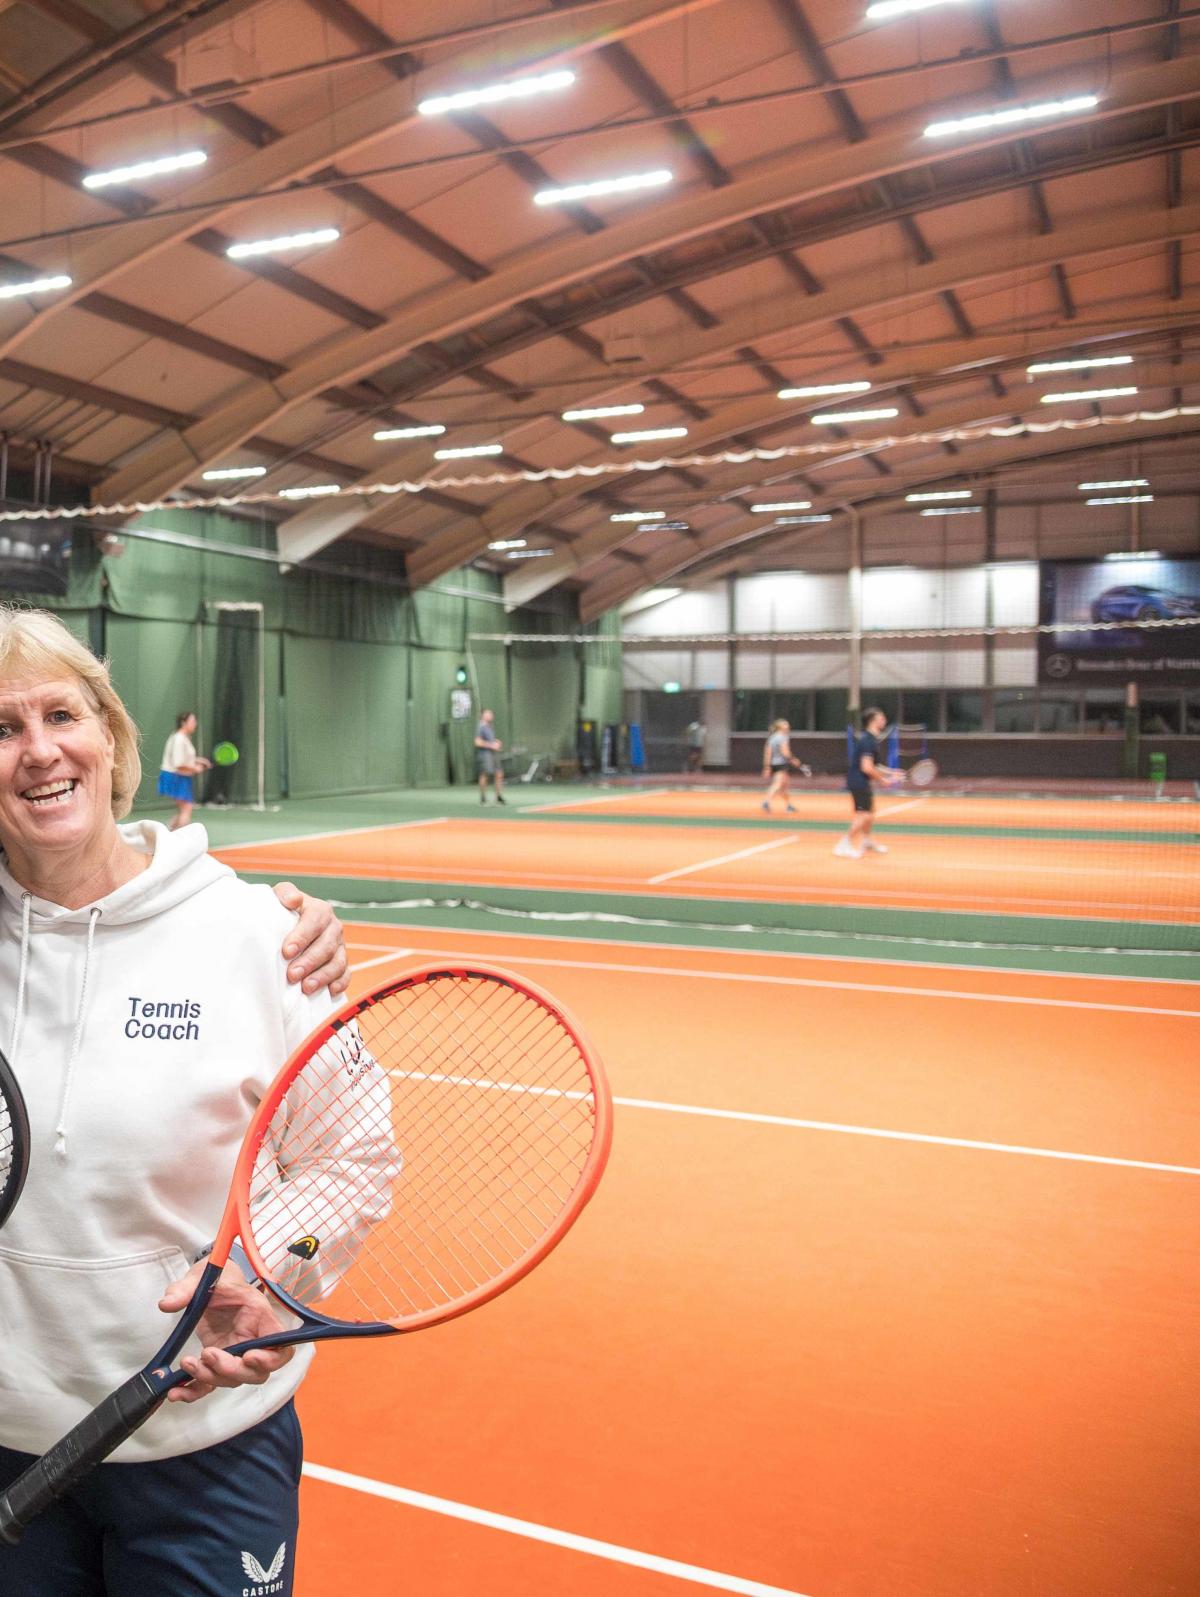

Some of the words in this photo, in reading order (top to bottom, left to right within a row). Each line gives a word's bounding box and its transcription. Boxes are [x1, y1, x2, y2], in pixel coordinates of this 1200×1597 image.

[128, 997, 201, 1018] Tennis
[124, 1019, 200, 1040] Coach
[242, 1580, 284, 1597] CASTORE
